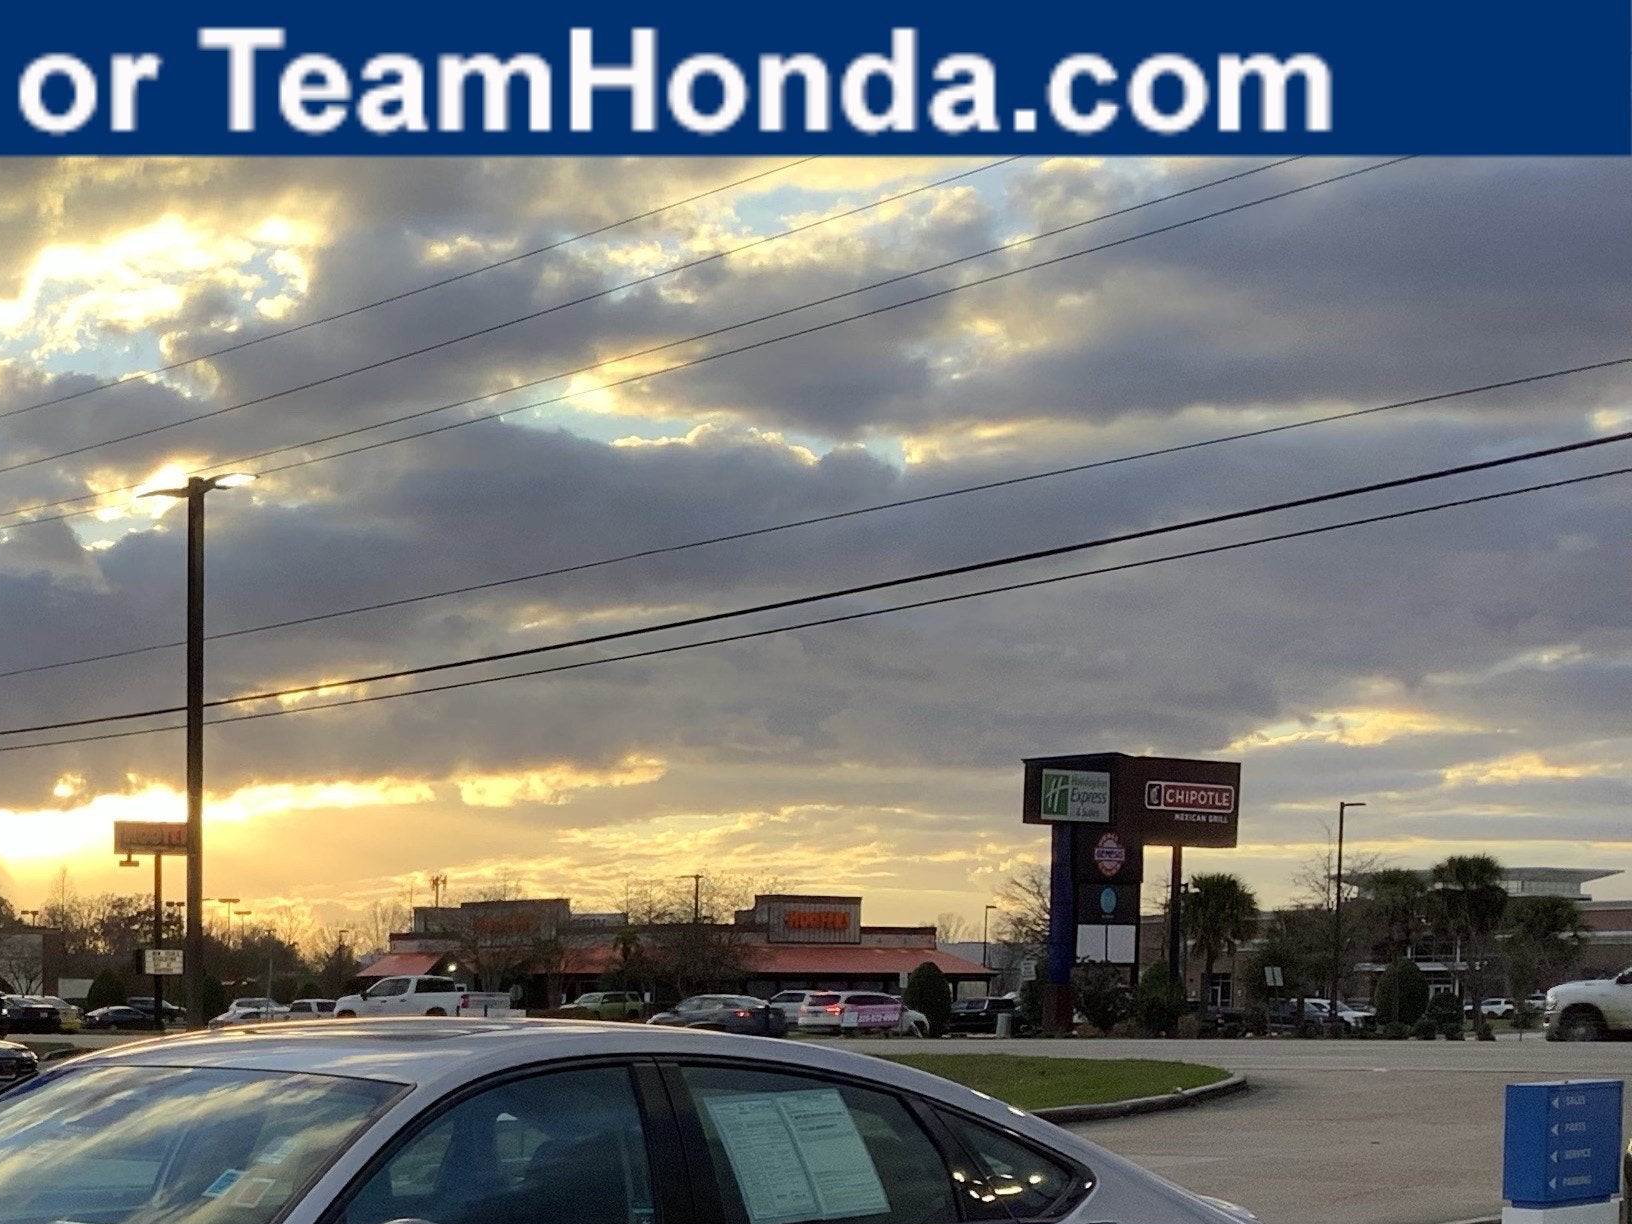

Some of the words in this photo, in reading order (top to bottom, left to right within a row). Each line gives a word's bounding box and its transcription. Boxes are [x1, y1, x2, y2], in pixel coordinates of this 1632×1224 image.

[1071, 787, 1107, 806] Express
[1165, 789, 1231, 806] CHIPOTLE
[1174, 813, 1207, 822] MEXICAN
[1208, 815, 1229, 824] GRILL
